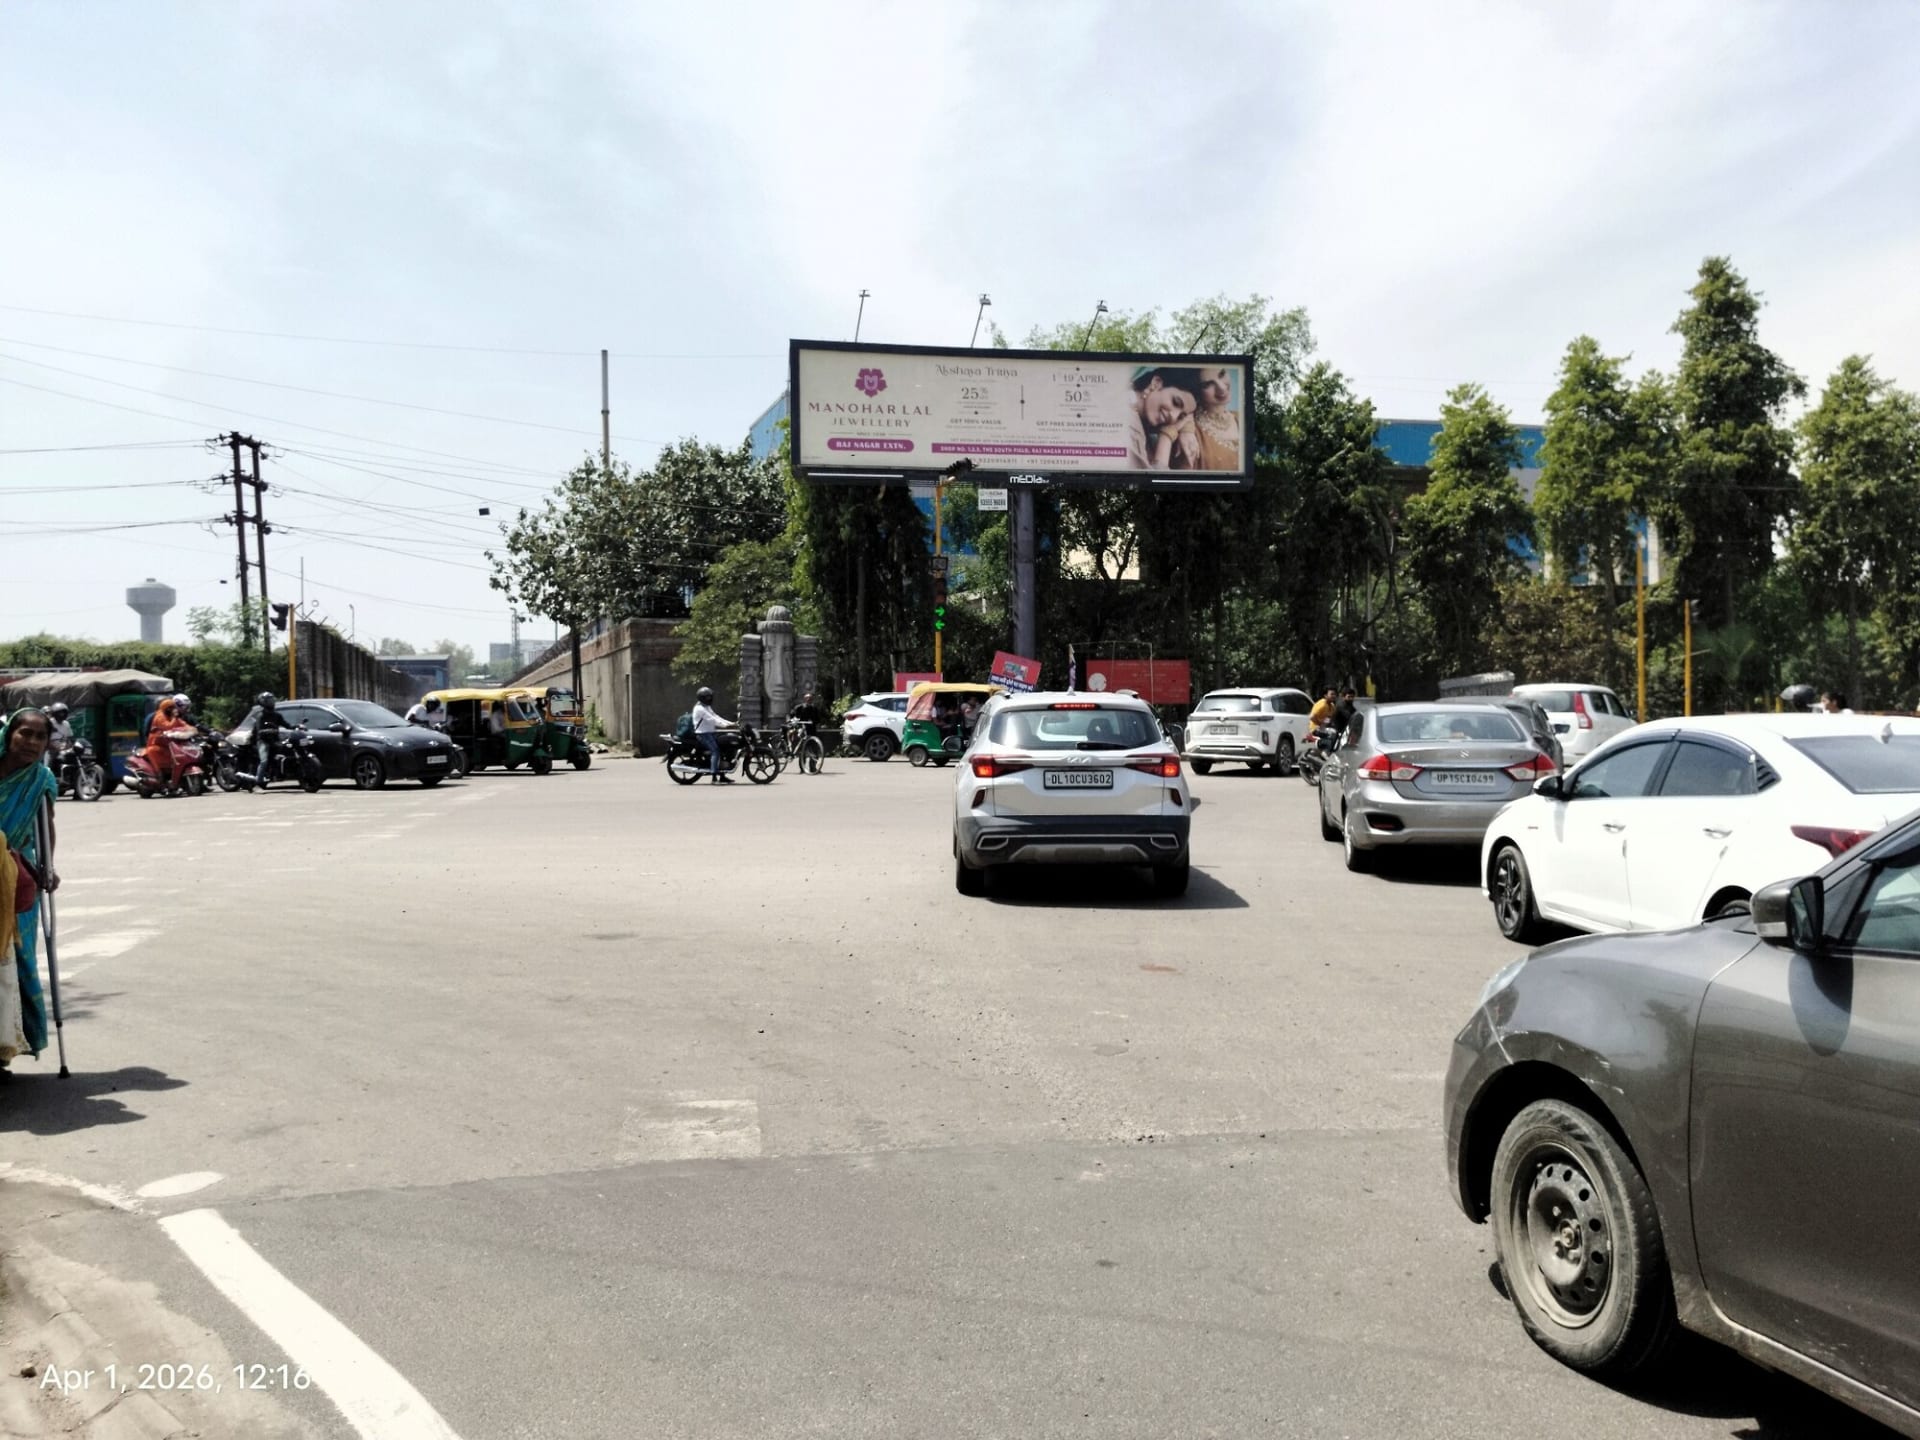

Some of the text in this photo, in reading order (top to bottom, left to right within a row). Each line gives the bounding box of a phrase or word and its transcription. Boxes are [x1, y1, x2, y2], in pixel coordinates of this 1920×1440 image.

[1078, 374, 1109, 383] APRIL
[808, 402, 933, 416] MANOHAR LAL
[832, 417, 911, 428] JEWELLERY
[854, 441, 880, 449] NAGAR
[883, 442, 907, 450] EXTN.
